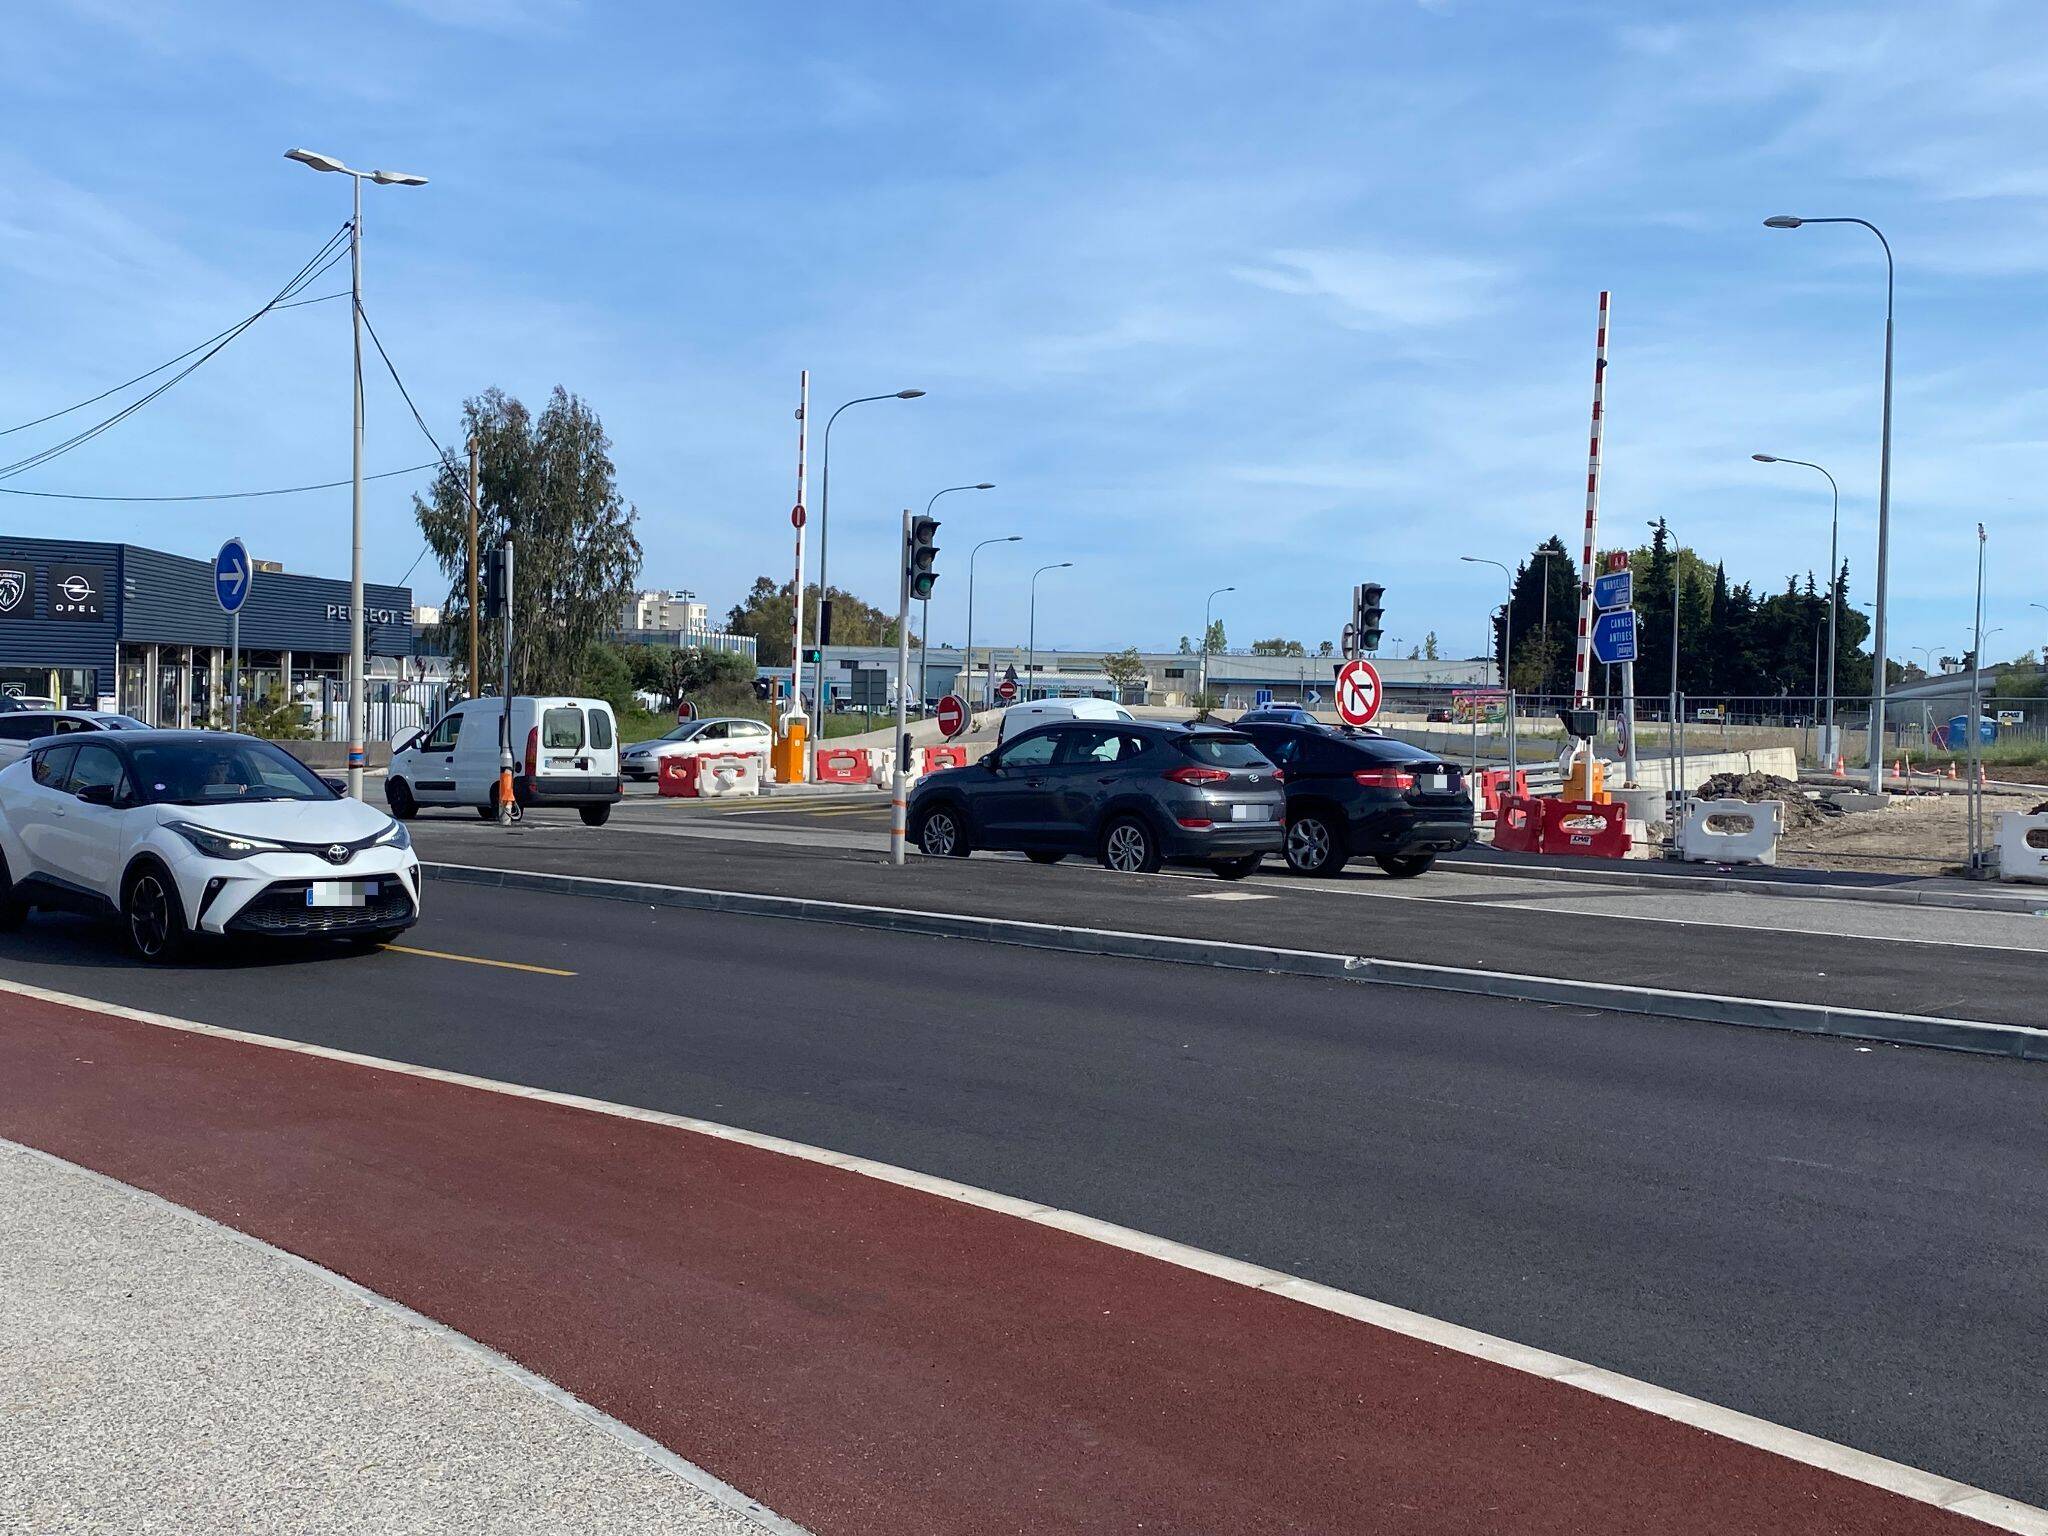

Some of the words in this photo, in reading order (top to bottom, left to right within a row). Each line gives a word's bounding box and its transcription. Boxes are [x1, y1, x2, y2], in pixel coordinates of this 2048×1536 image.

[55, 604, 97, 613] OPEL
[1611, 617, 1632, 629] CANNES
[1610, 630, 1633, 642] ANTIBES
